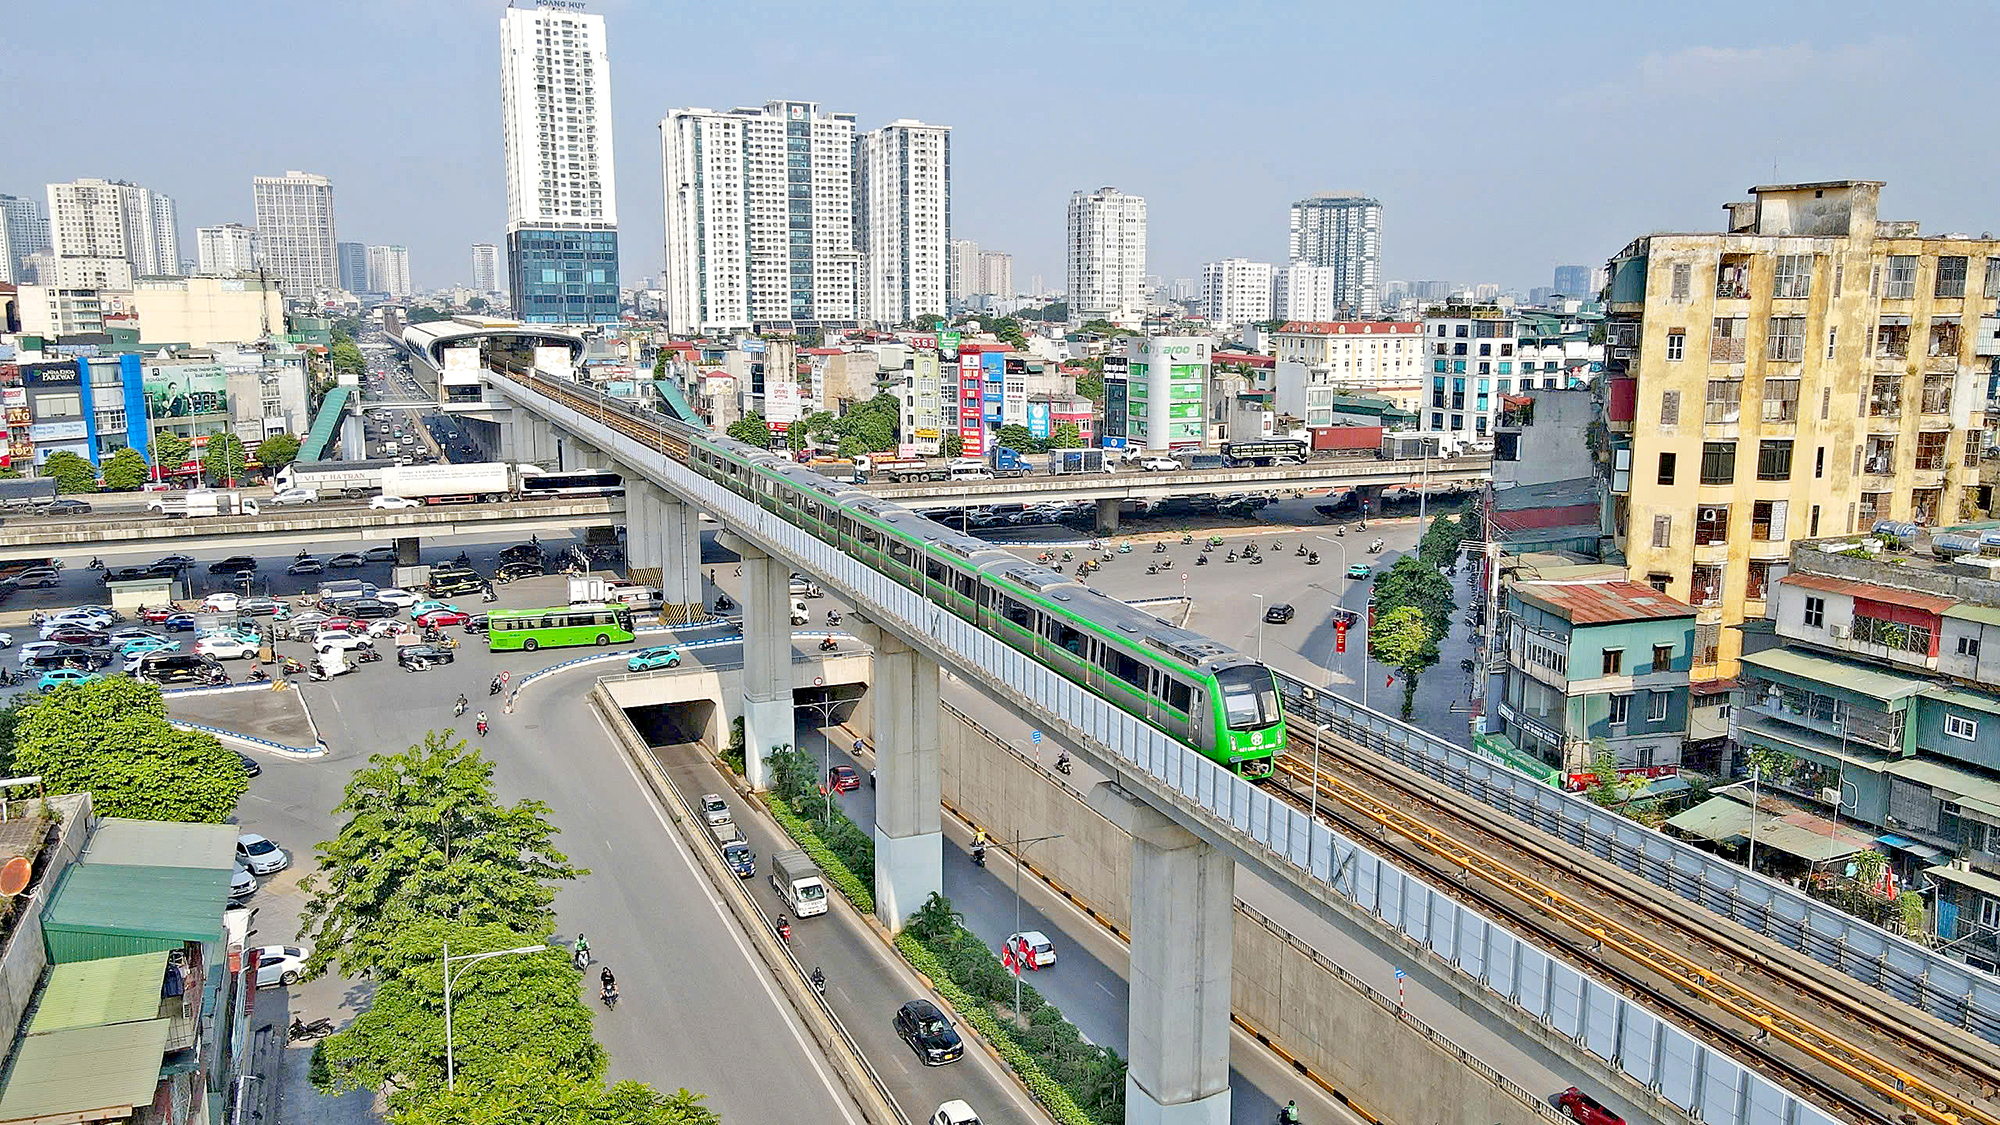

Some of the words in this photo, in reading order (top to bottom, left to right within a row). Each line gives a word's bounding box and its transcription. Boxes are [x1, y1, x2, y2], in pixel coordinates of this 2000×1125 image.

[568, 1, 586, 9] HUY
[914, 339, 935, 347] 369
[42, 371, 76, 381] PARKWAY
[9, 412, 30, 422] ATG
[9, 446, 35, 456] TOPY
